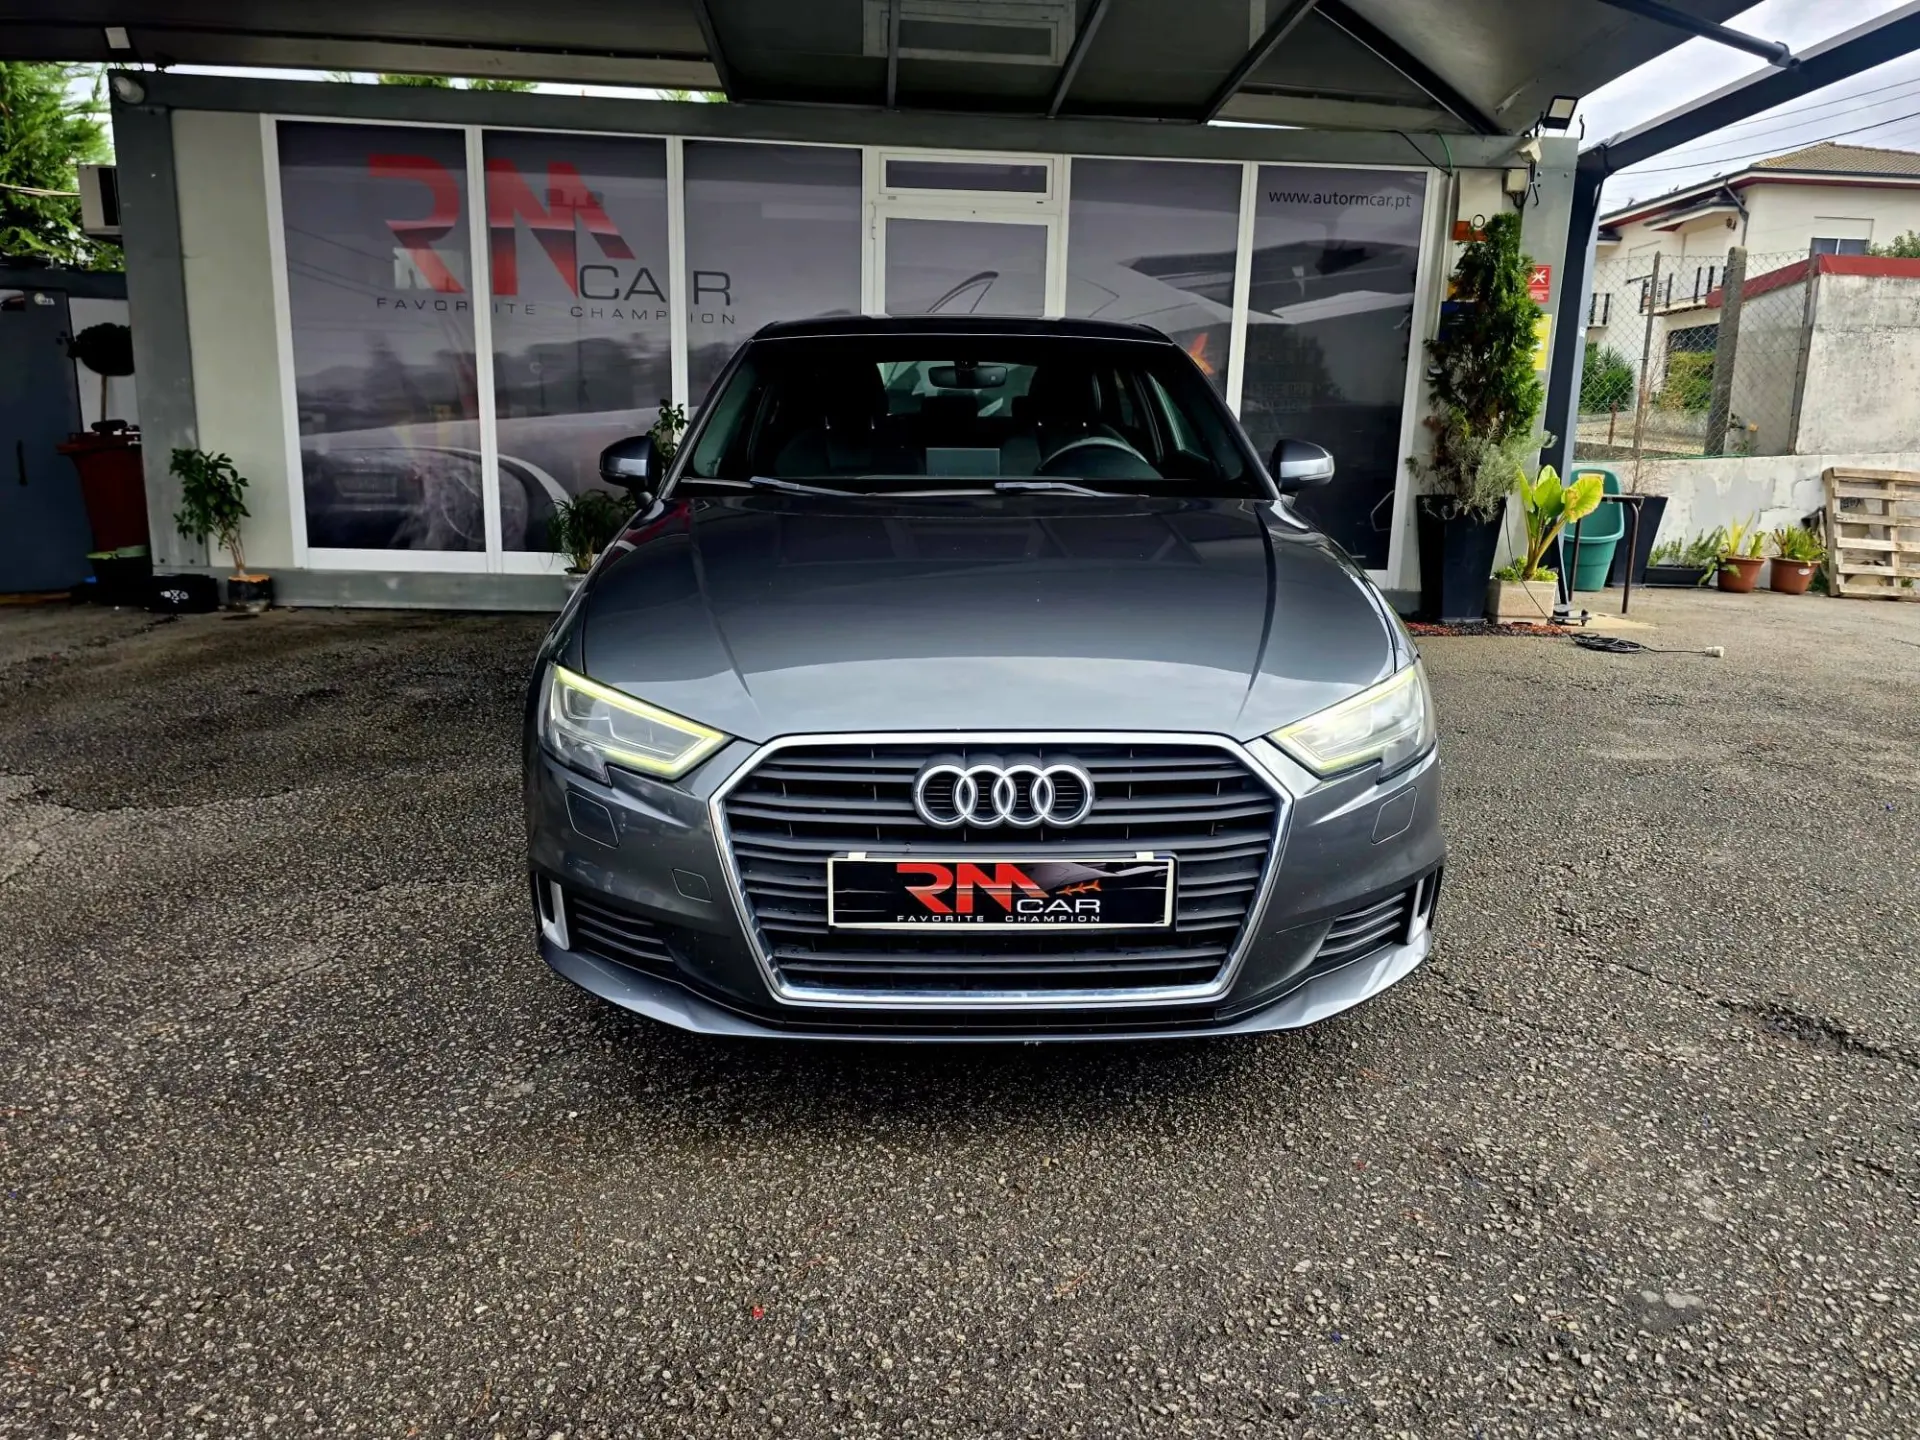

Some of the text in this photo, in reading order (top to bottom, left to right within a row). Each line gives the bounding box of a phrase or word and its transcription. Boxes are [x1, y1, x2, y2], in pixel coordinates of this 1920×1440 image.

[1268, 191, 1412, 210] www.autormcar.pt
[368, 153, 731, 306] RM CAR
[376, 296, 736, 325] FAVORITE CHAMPION
[896, 863, 1101, 914] RM CAR
[896, 915, 1101, 923] FAVORITE CHAMPION
